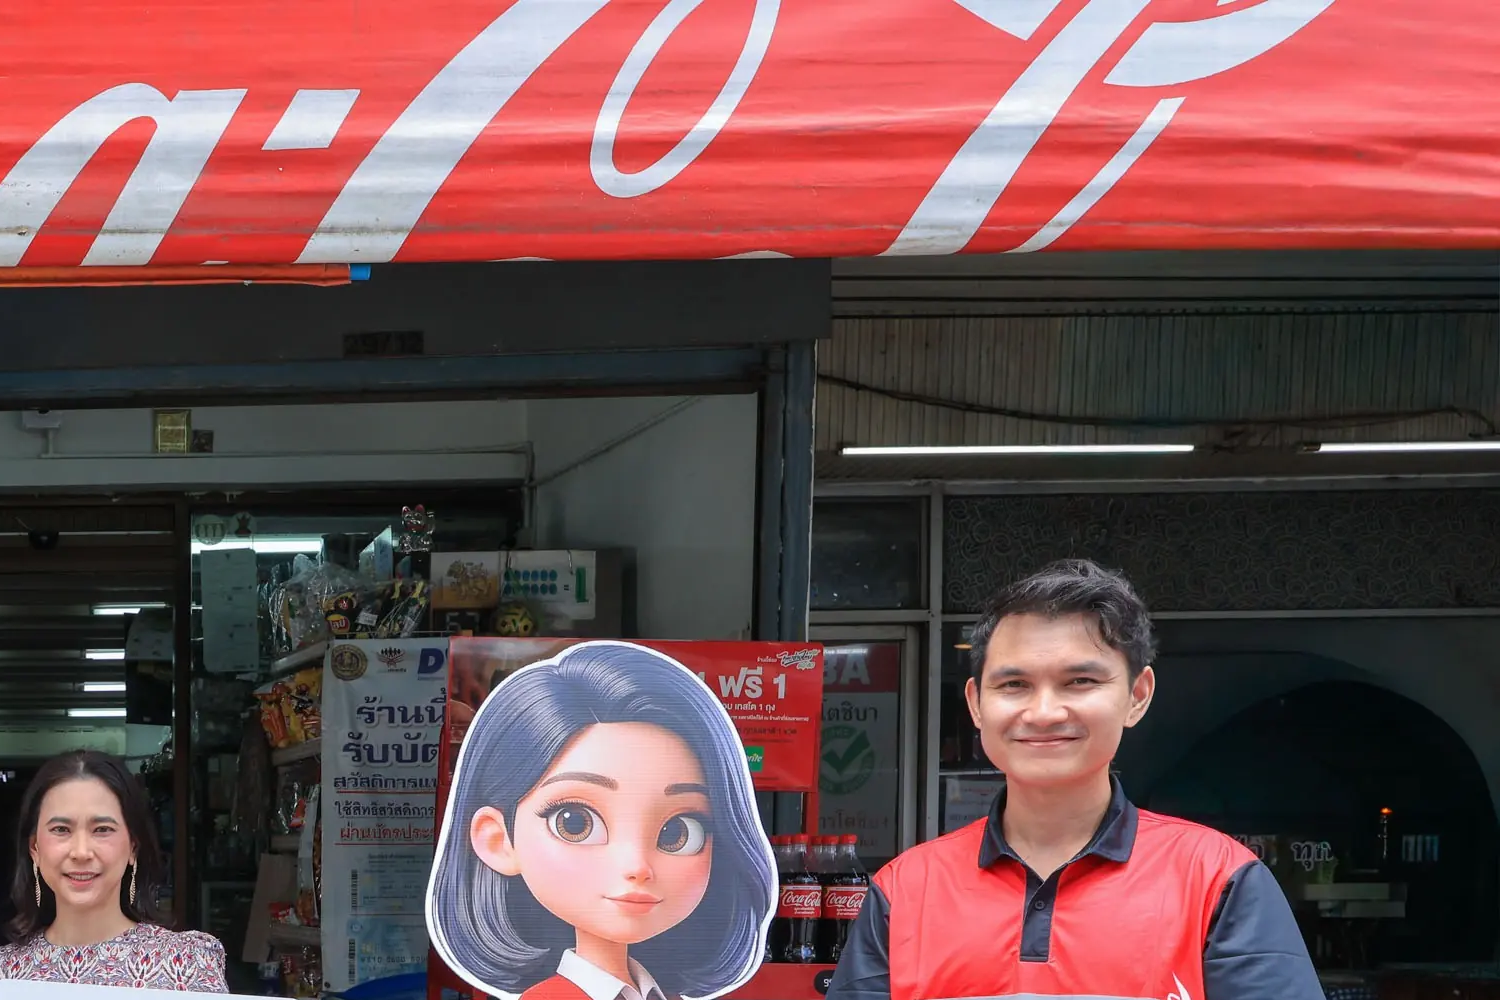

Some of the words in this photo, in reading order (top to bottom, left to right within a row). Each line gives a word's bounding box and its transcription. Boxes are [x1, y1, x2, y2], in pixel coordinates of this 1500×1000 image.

[718, 666, 763, 699] ฟรี
[773, 672, 787, 699] 1
[340, 821, 435, 840] ผ่านบัตรประ
[826, 892, 866, 909] Coca-Col
